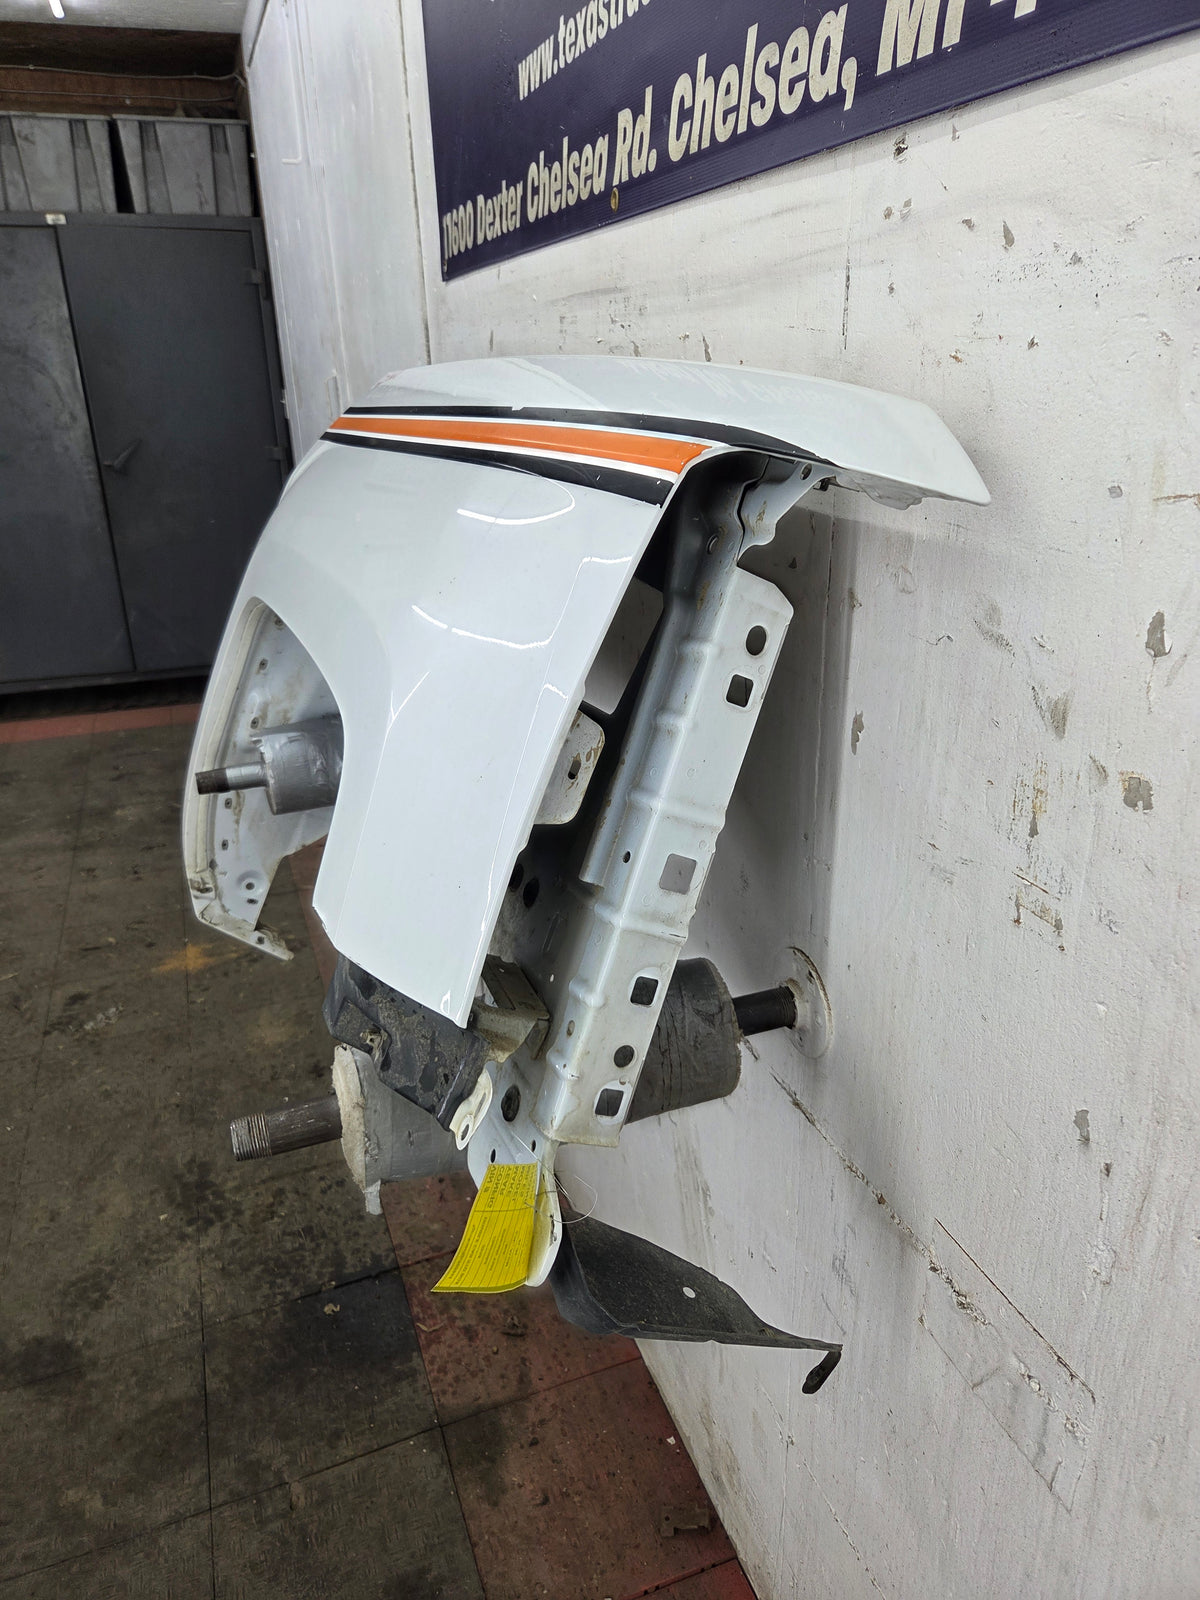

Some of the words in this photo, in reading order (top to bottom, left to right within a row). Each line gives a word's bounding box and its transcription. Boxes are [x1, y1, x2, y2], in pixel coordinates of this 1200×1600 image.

[443, 200, 475, 260] 11600
[477, 180, 523, 246] Dexter
[527, 133, 609, 223] Chelsea
[612, 85, 657, 186] Rd.
[668, 3, 858, 162] Chelsea,
